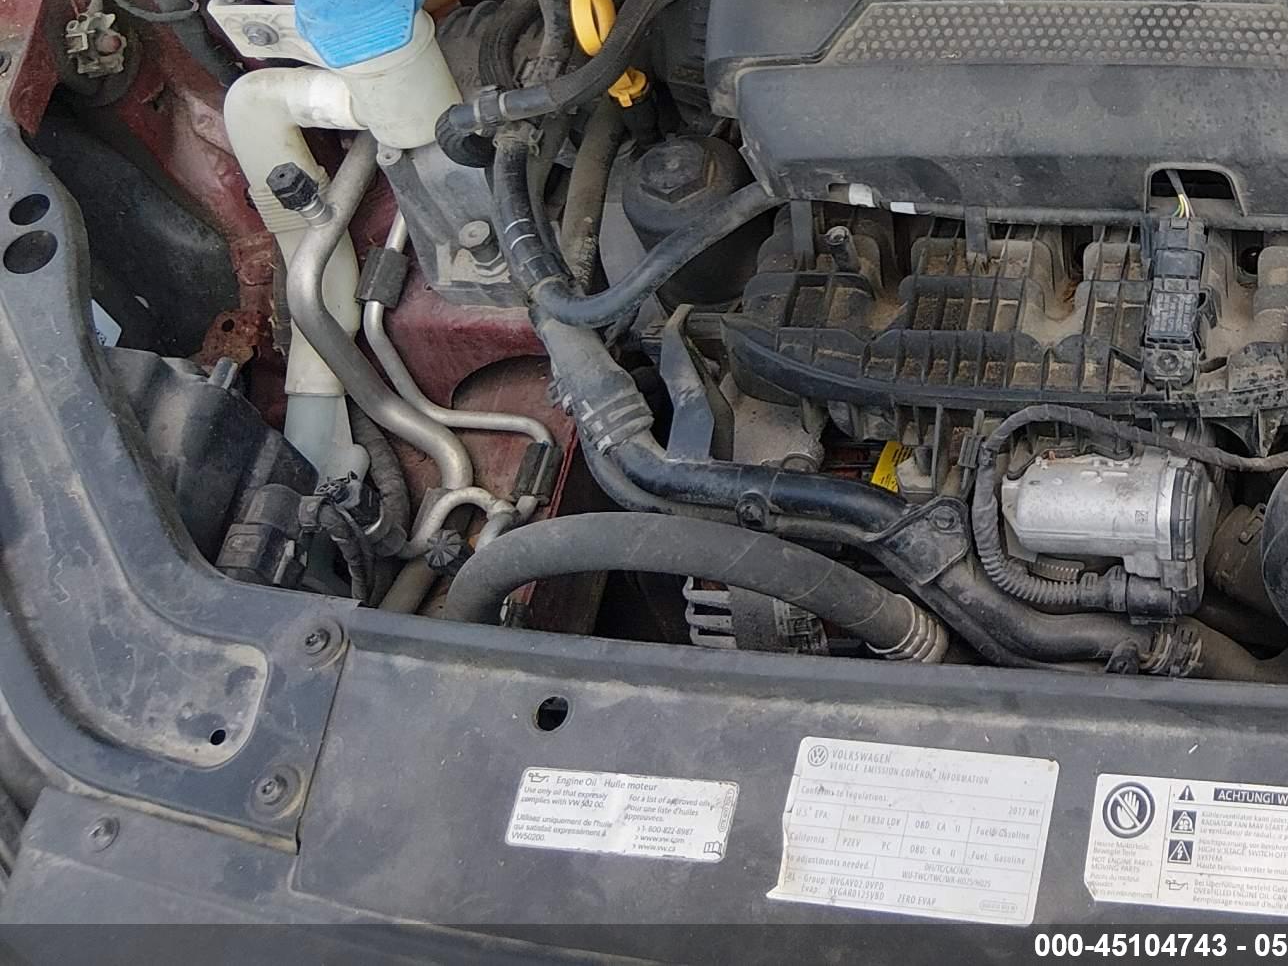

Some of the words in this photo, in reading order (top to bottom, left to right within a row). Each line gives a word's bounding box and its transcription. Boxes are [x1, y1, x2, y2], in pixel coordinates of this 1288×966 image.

[832, 748, 891, 764] VOLKSWAGEN
[830, 761, 857, 771] VEHICLE
[863, 765, 898, 775] EMISSION
[901, 768, 934, 779] CONTROL
[938, 771, 990, 785] INFORMATION
[556, 776, 584, 786] Engine
[604, 779, 625, 787] Huile
[627, 782, 656, 790] moteur
[1218, 790, 1273, 803] ACHTUNG!
[1008, 805, 1026, 816] 2017
